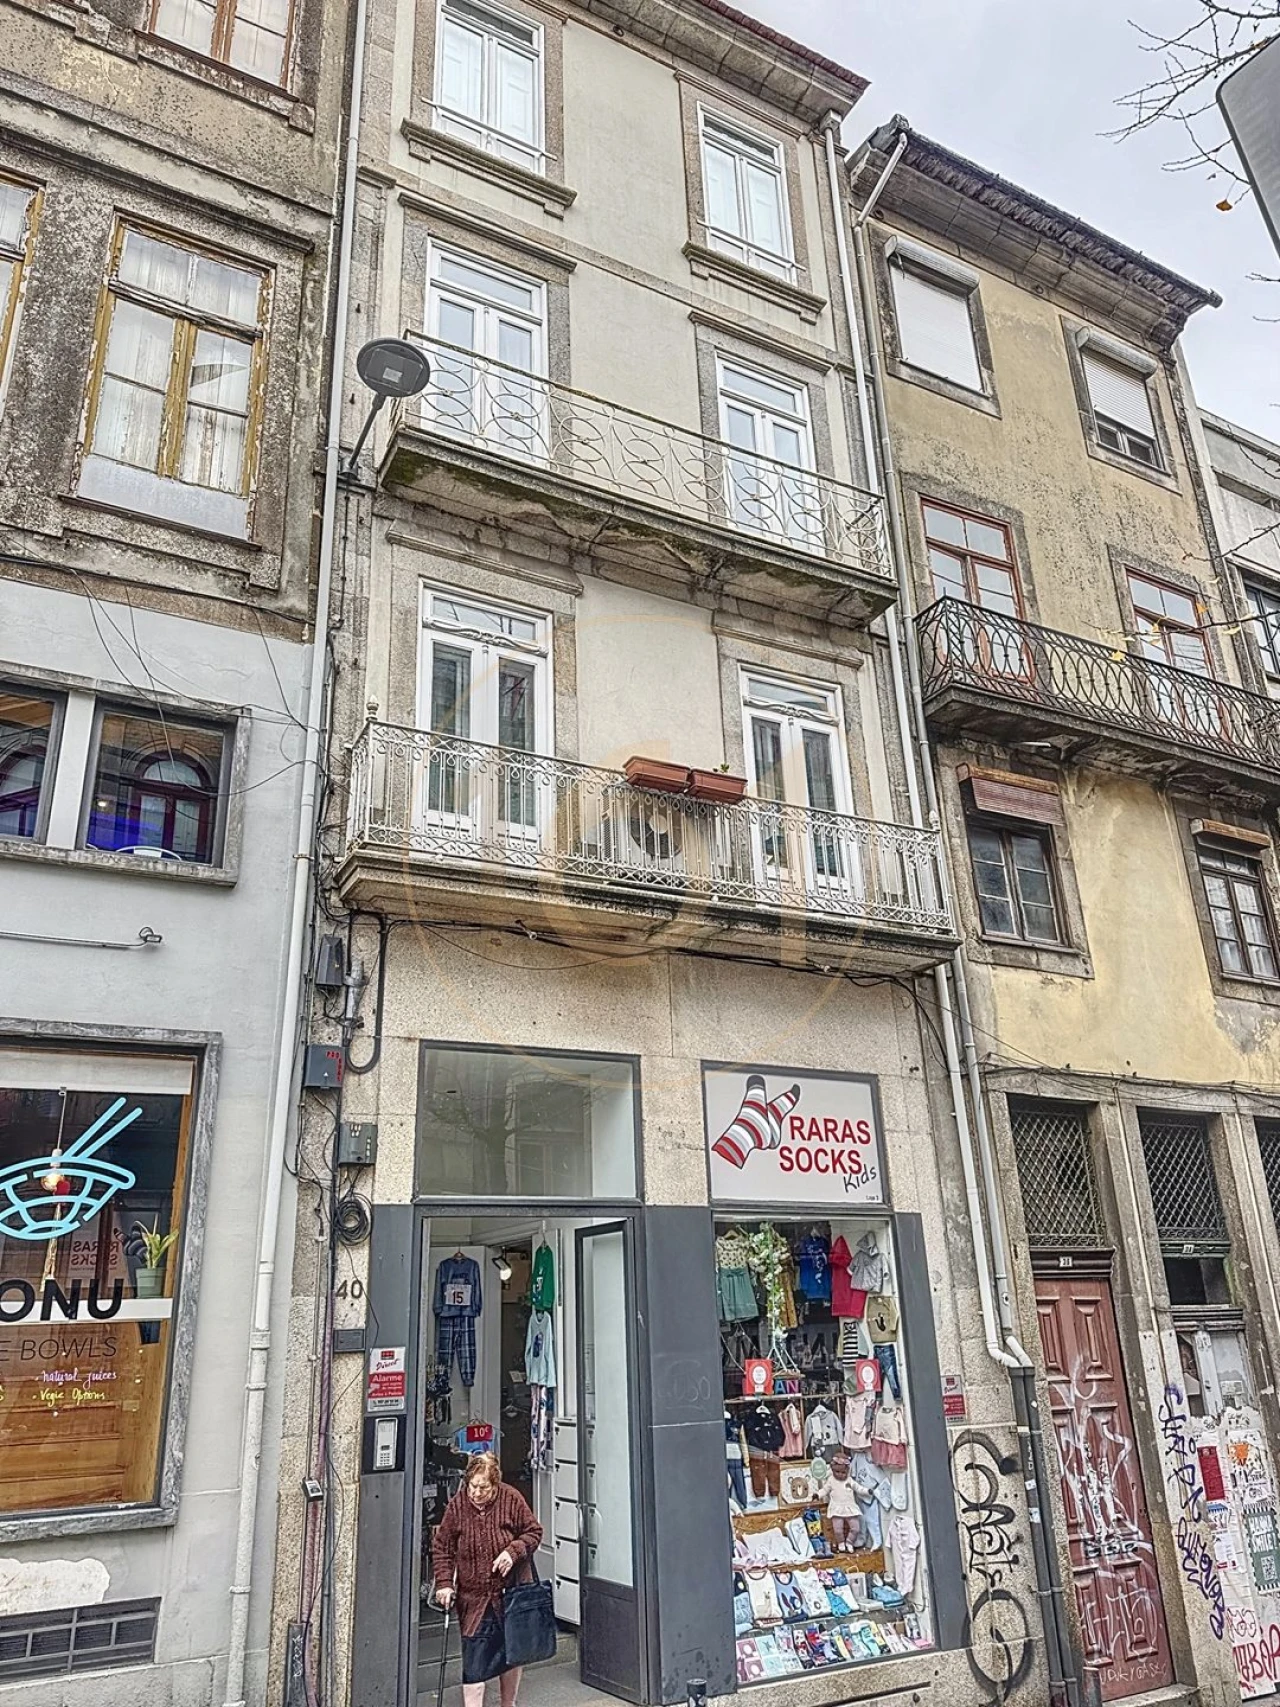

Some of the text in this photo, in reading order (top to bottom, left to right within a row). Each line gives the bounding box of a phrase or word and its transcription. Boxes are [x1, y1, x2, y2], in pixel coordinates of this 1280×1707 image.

[789, 1115, 872, 1145] RARAS
[778, 1145, 863, 1175] SOCKS
[842, 1163, 878, 1193] Kids
[0, 1278, 124, 1322] ONU
[335, 1279, 363, 1299] 40
[452, 1290, 464, 1304] 15
[20, 1336, 117, 1361] BOWLS
[42, 1367, 82, 1384] natural
[372, 1374, 403, 1382] Alarme
